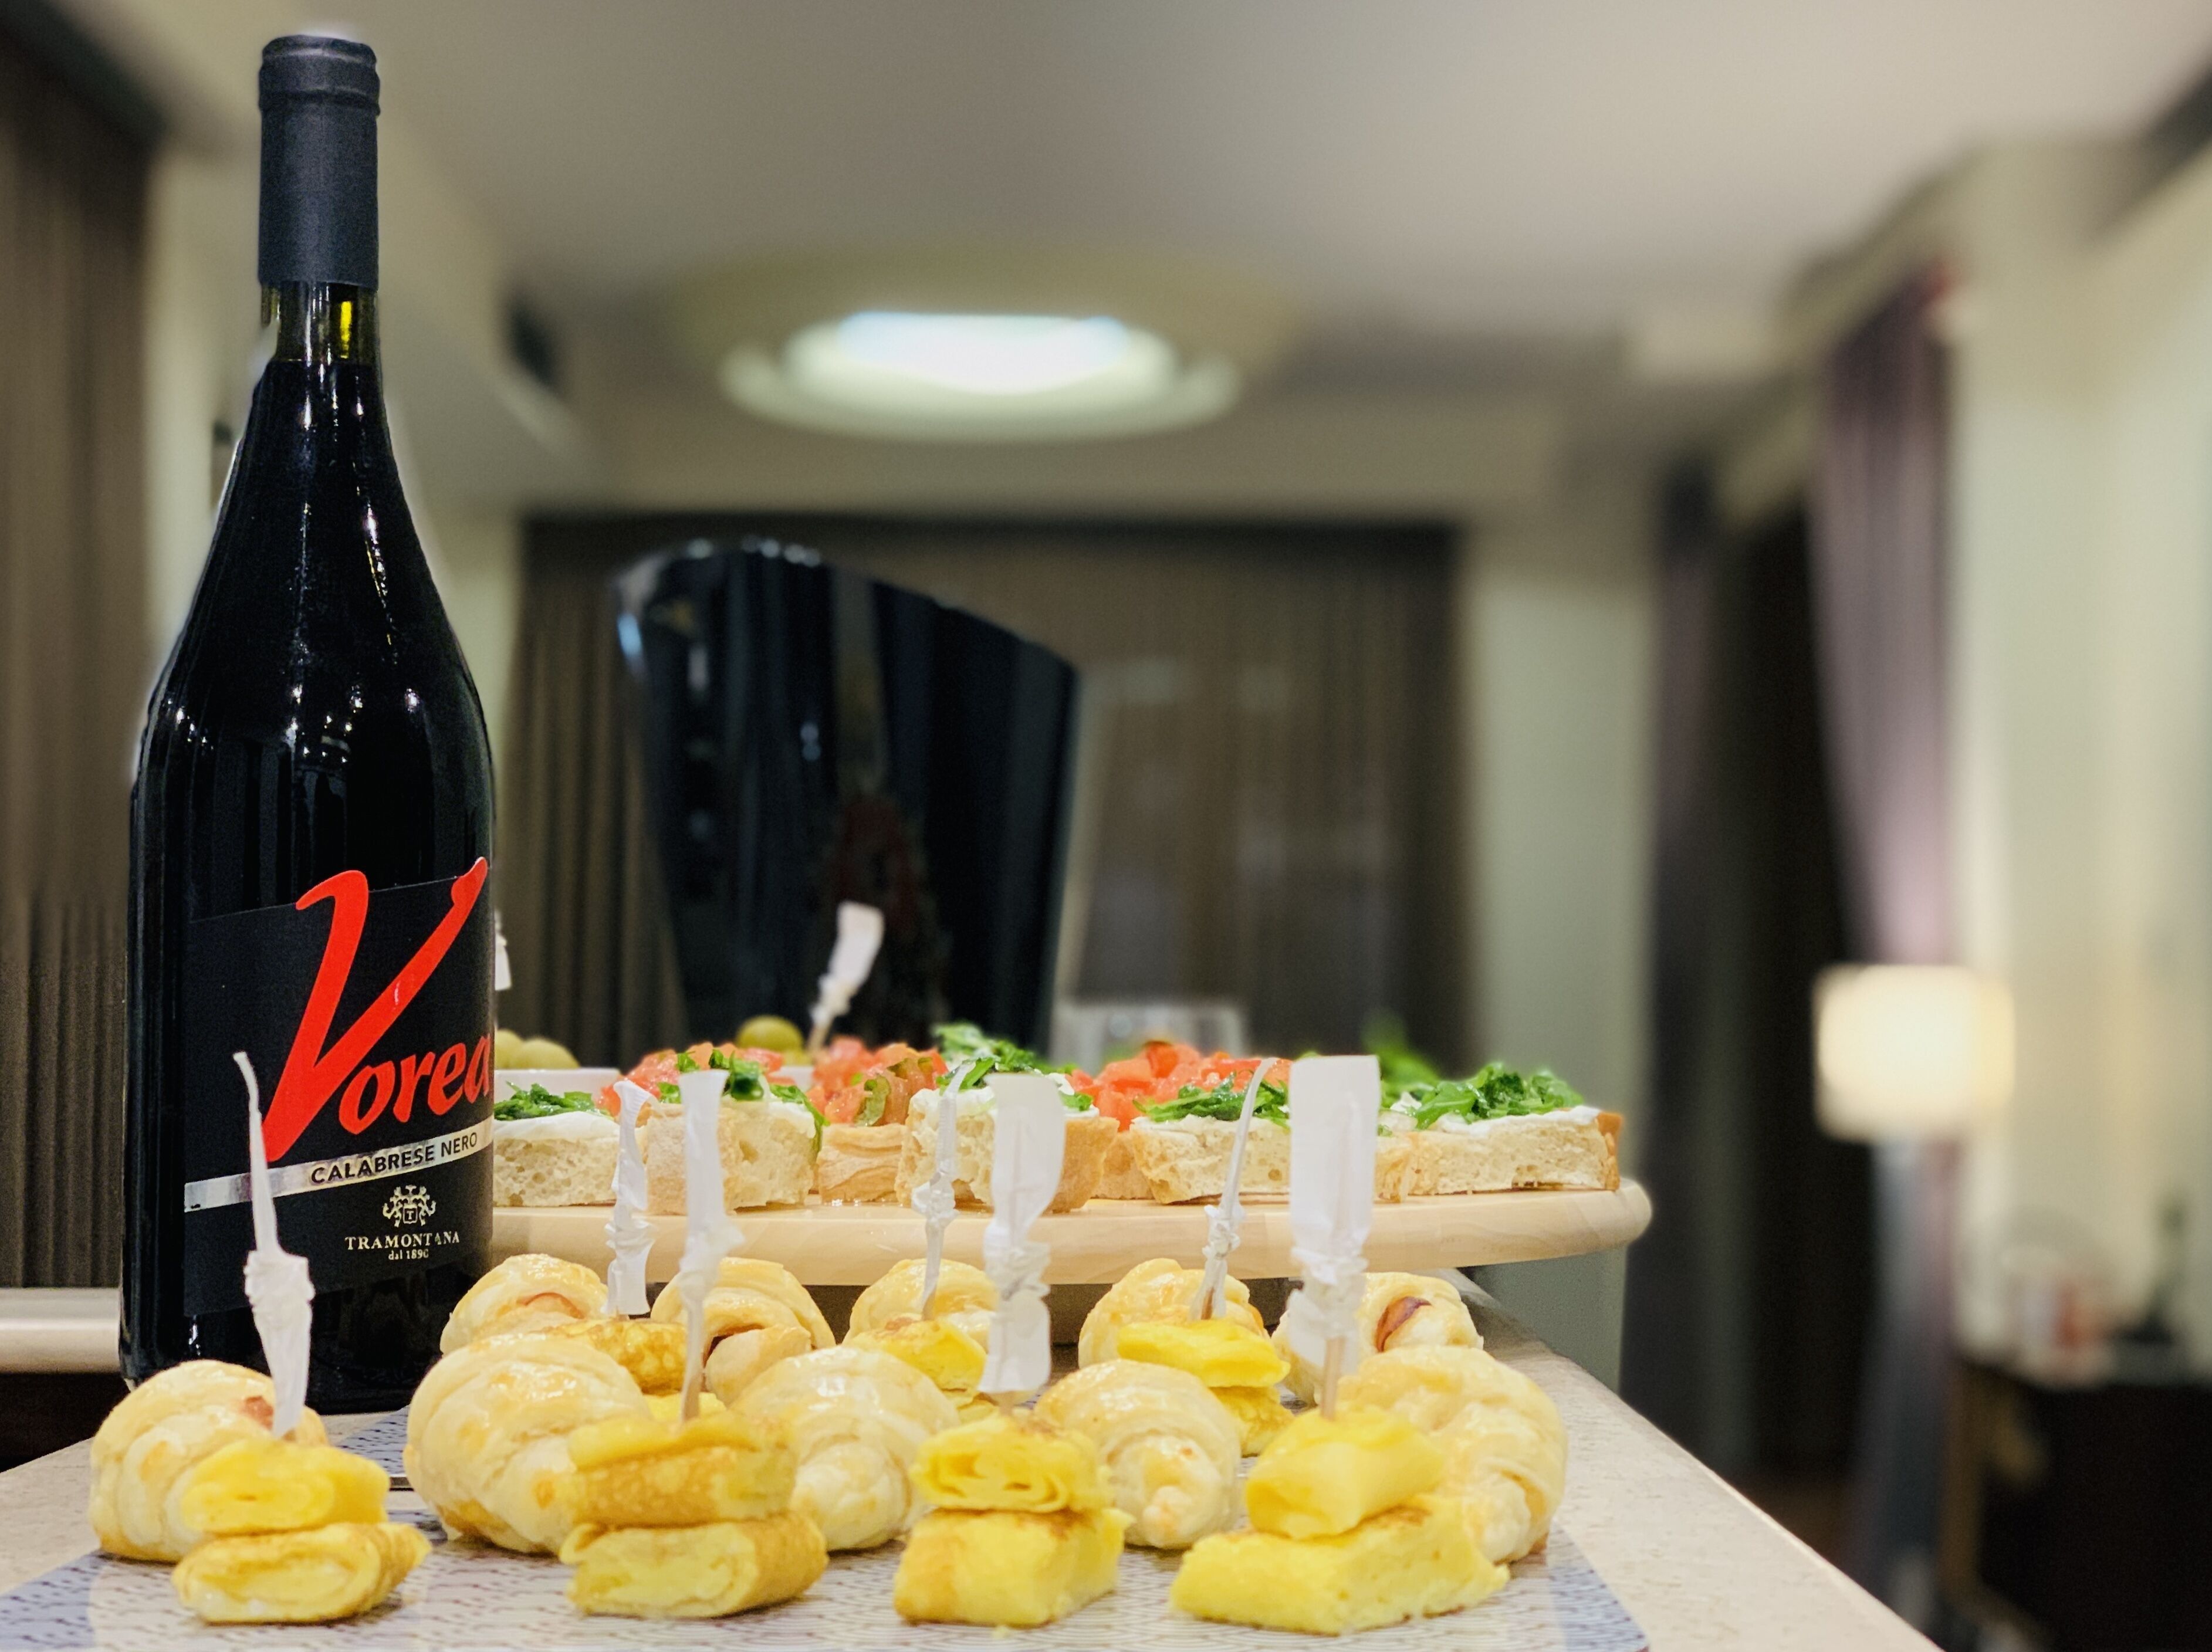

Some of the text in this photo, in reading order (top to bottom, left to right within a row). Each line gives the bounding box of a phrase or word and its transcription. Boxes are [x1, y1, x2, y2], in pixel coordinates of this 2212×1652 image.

[262, 857, 491, 1162] Vorea
[310, 1132, 478, 1184] CALABRESE NERO
[344, 1231, 460, 1250] TRAMONTANA
[388, 1248, 429, 1260] dal 1890
